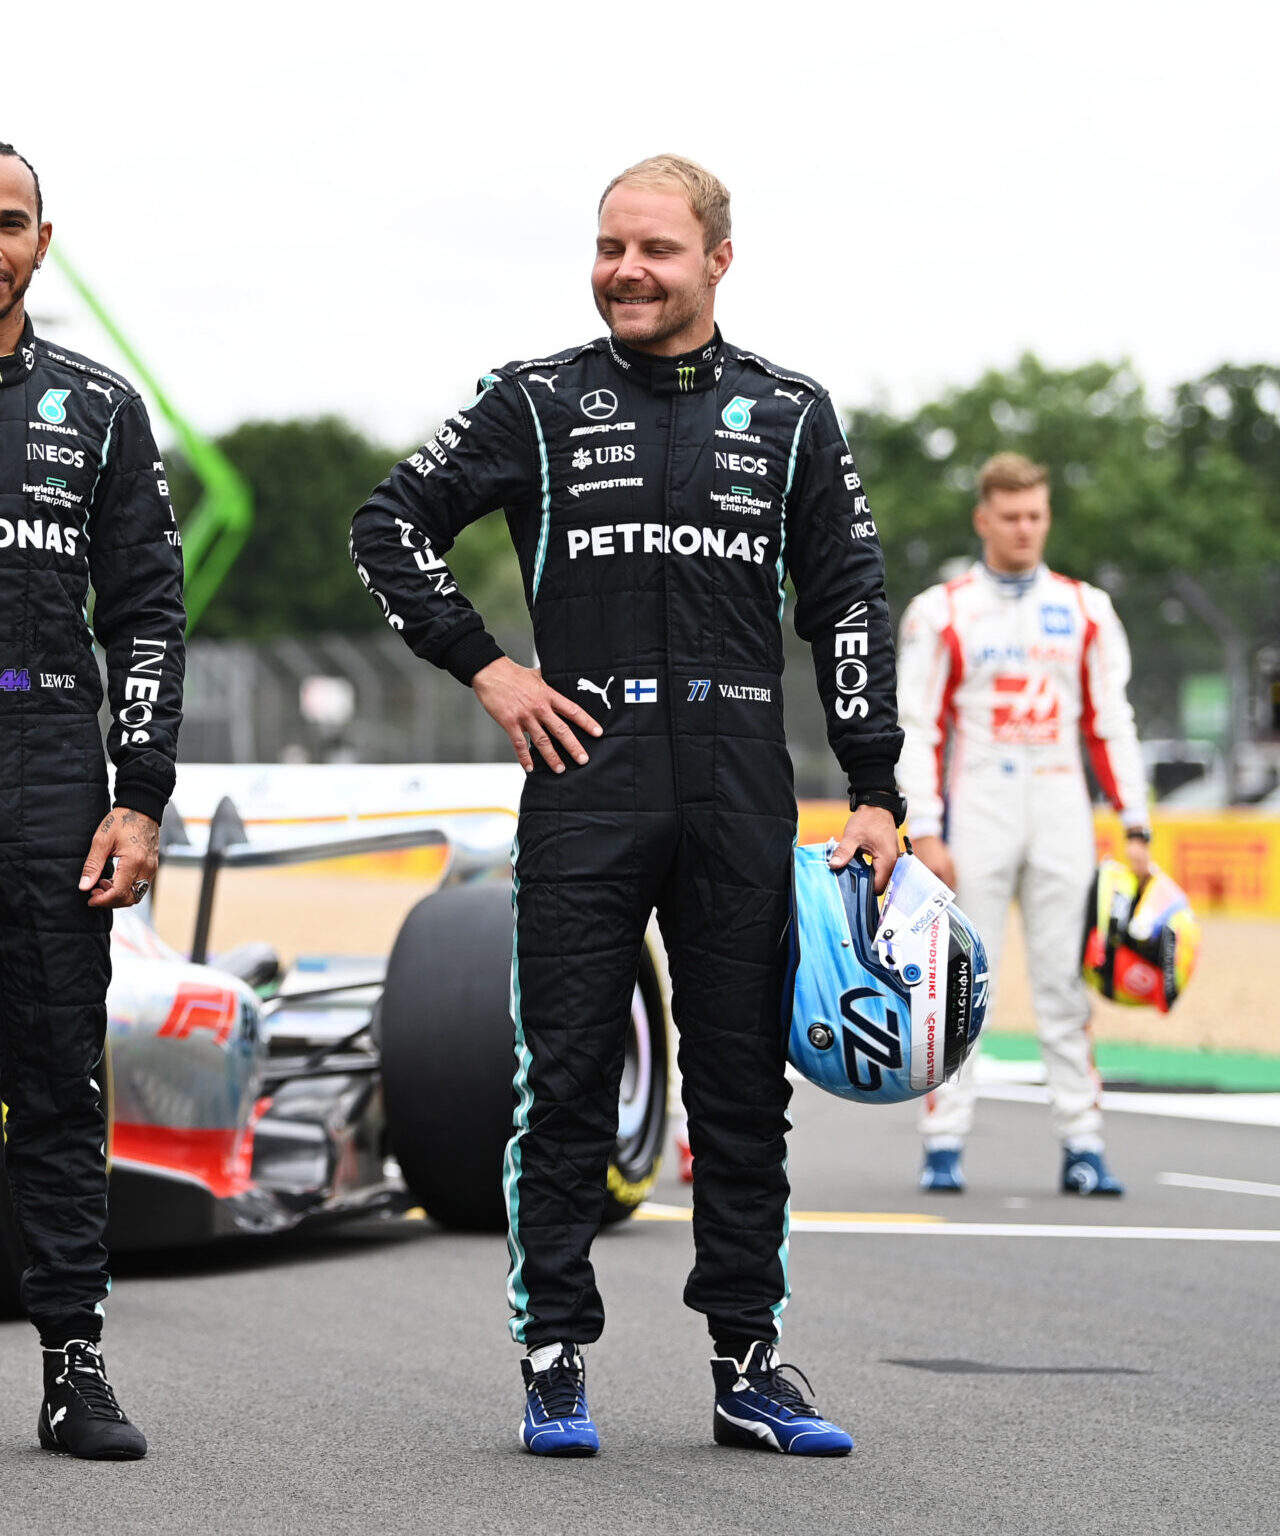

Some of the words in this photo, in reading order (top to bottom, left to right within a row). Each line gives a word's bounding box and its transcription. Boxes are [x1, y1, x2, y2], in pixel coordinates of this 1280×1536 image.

[29, 422, 78, 436] PETRONAS
[435, 423, 462, 449] SON
[715, 430, 761, 443] PETRONAS
[26, 443, 85, 468] INEOS
[595, 444, 635, 464] UBS
[715, 451, 768, 476] NEOS
[22, 483, 55, 495] Hewlett
[572, 478, 644, 493] CROWDSTRIKE
[34, 493, 72, 508] Enterprise
[720, 501, 761, 516] Enterprise
[742, 496, 772, 510] Packard
[567, 523, 770, 565] PETRONAS
[834, 600, 869, 720] NEOS
[40, 673, 76, 689] LEWIS
[119, 636, 167, 747] INEOS
[687, 679, 712, 701] 77
[718, 684, 772, 702] VALTTERI
[911, 909, 935, 934] EPSON
[928, 918, 941, 1000] CROWDSTRIKE
